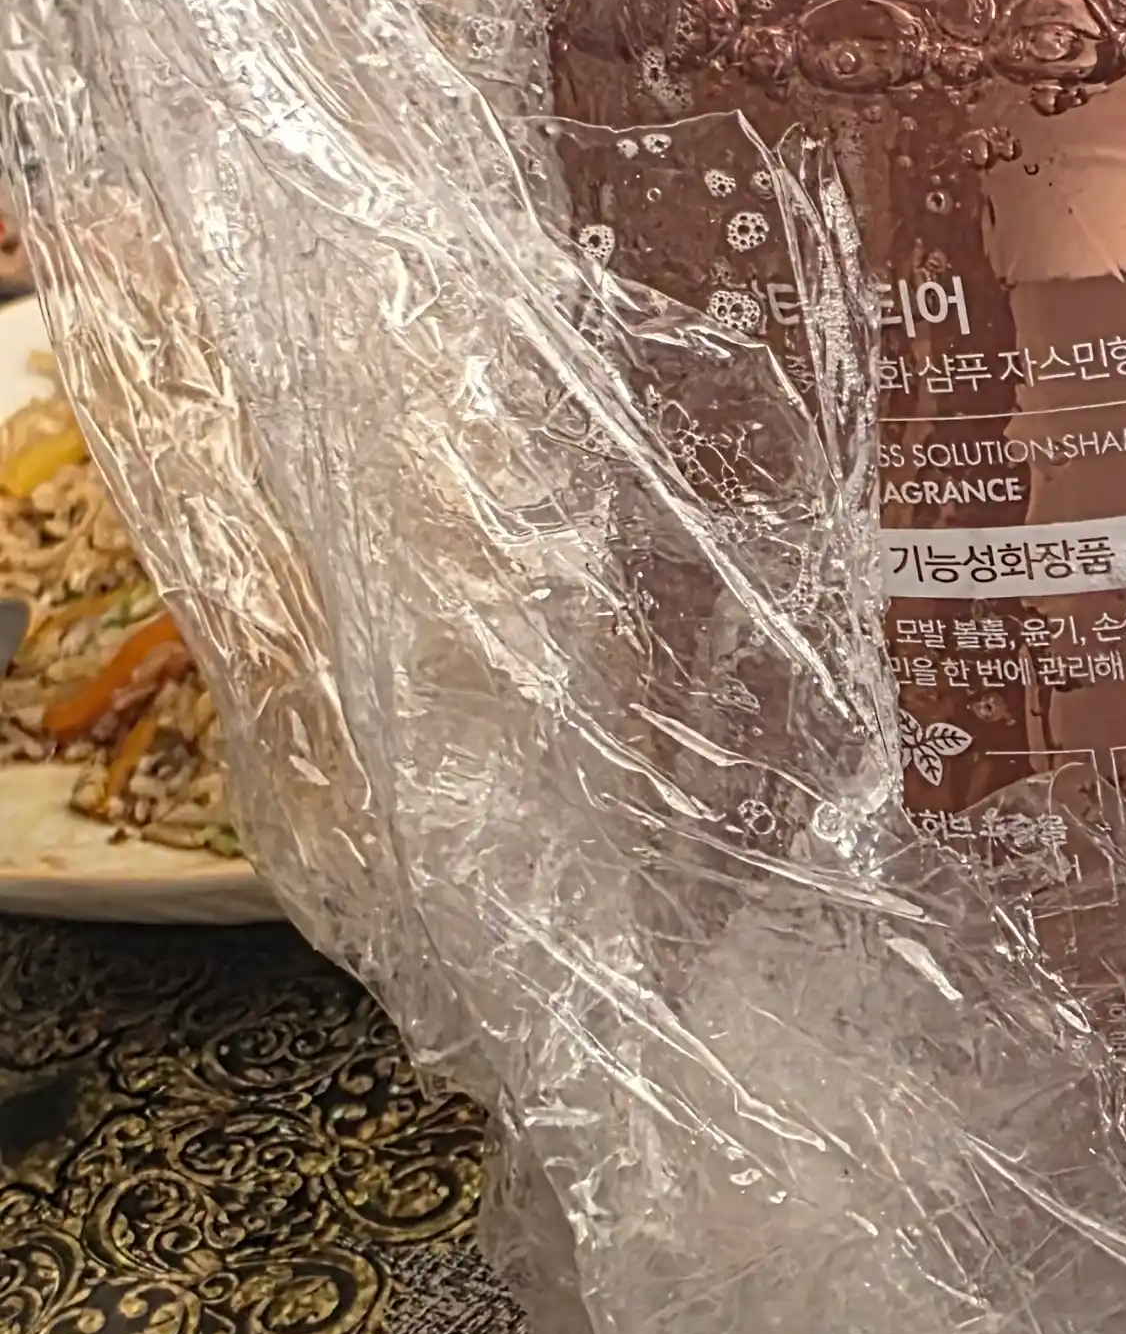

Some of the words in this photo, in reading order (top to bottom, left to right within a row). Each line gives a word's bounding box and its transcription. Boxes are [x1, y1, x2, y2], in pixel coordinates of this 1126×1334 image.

[918, 353, 992, 394] 샴푸
[913, 436, 1055, 468] SOLUTION
[880, 477, 1023, 505] AGRANCE
[889, 536, 1116, 583] 기능성화장품
[895, 619, 946, 648] 모발
[1021, 615, 1086, 647] 윤기,
[1038, 652, 1125, 687] 관리해
